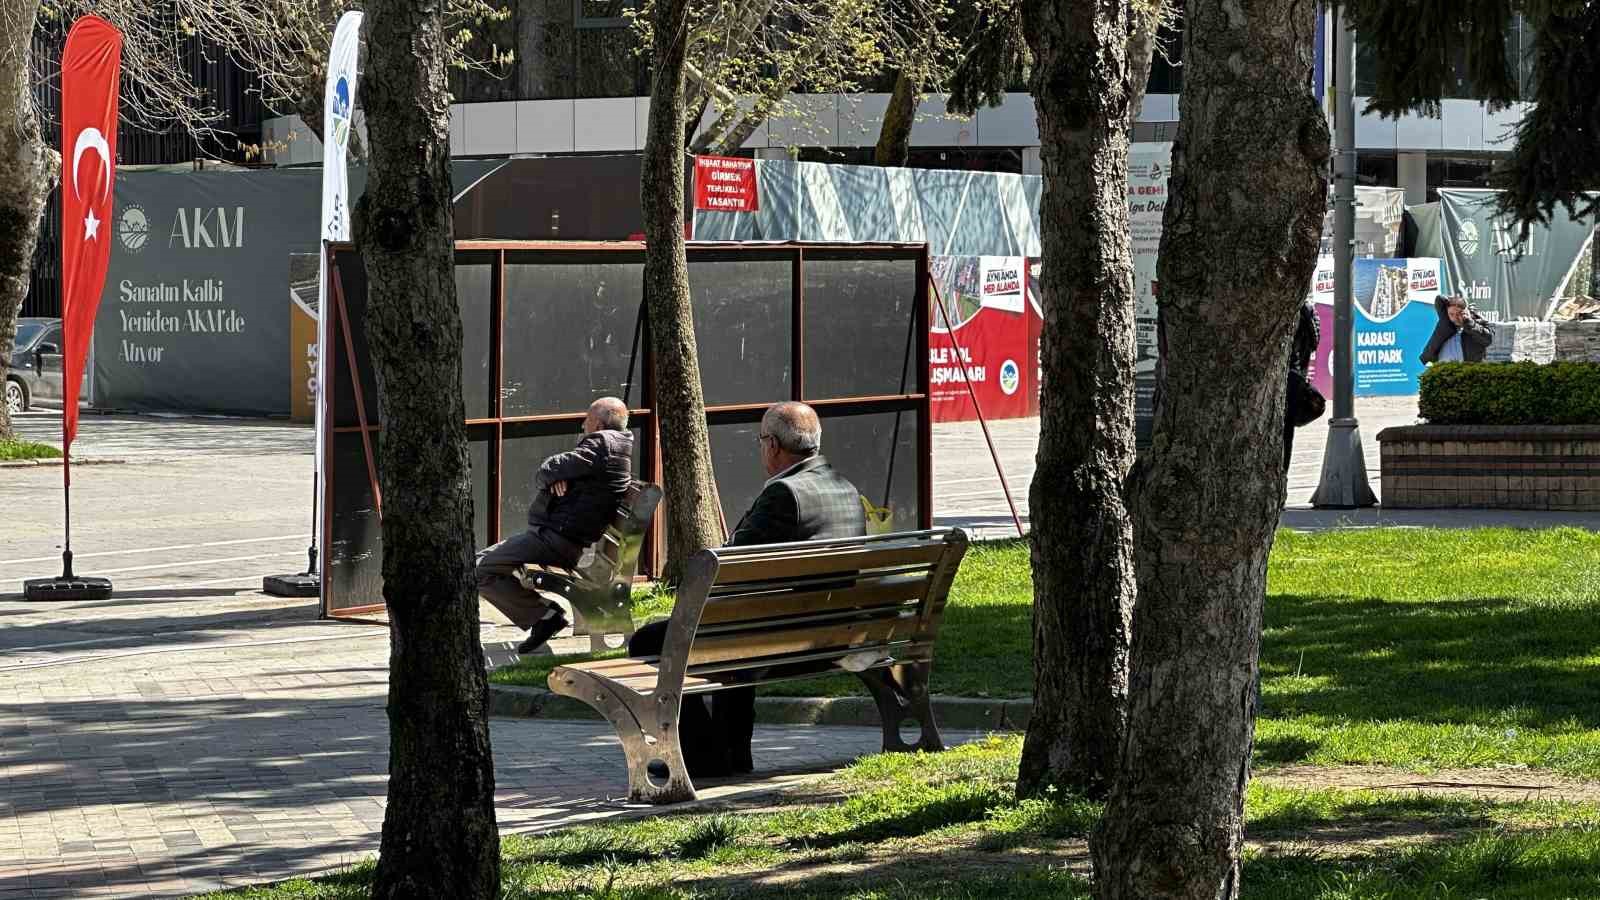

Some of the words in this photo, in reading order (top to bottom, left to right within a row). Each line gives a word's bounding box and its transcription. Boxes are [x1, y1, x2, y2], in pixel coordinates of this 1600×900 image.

[169, 207, 245, 248] AKM
[1001, 269, 1018, 281] ANDA
[119, 279, 180, 302] Sanatın
[183, 279, 224, 302] Kalbi
[984, 283, 995, 294] HER
[996, 280, 1020, 291] ALANDA
[119, 309, 180, 333] Yeniden
[183, 309, 246, 333] AKM'de
[1357, 331, 1396, 346] KARASU
[1357, 350, 1377, 365] KIYI
[1378, 349, 1403, 364] PARK
